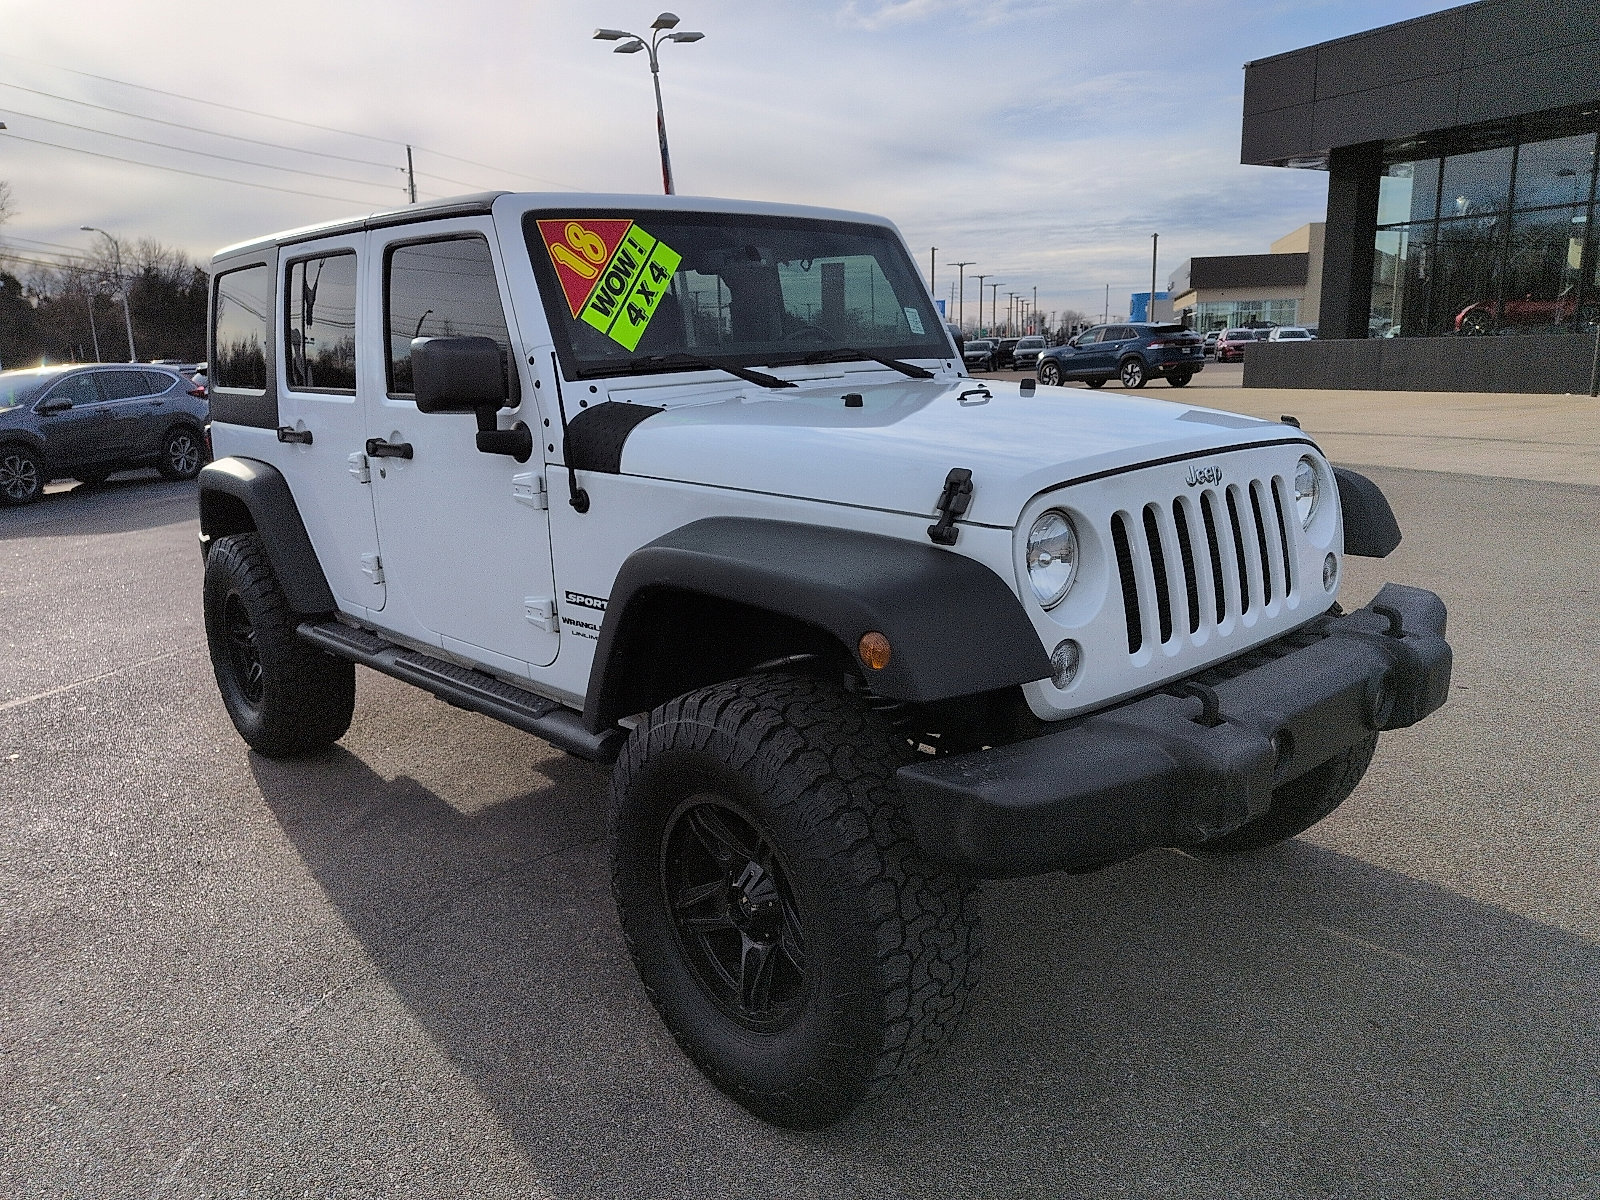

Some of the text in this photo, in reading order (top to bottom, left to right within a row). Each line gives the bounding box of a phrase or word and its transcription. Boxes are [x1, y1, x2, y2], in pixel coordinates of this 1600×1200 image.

[550, 222, 607, 279] 18
[1185, 465, 1223, 487] Jeep
[568, 594, 609, 609] SPORT
[562, 617, 602, 631] WRANGL
